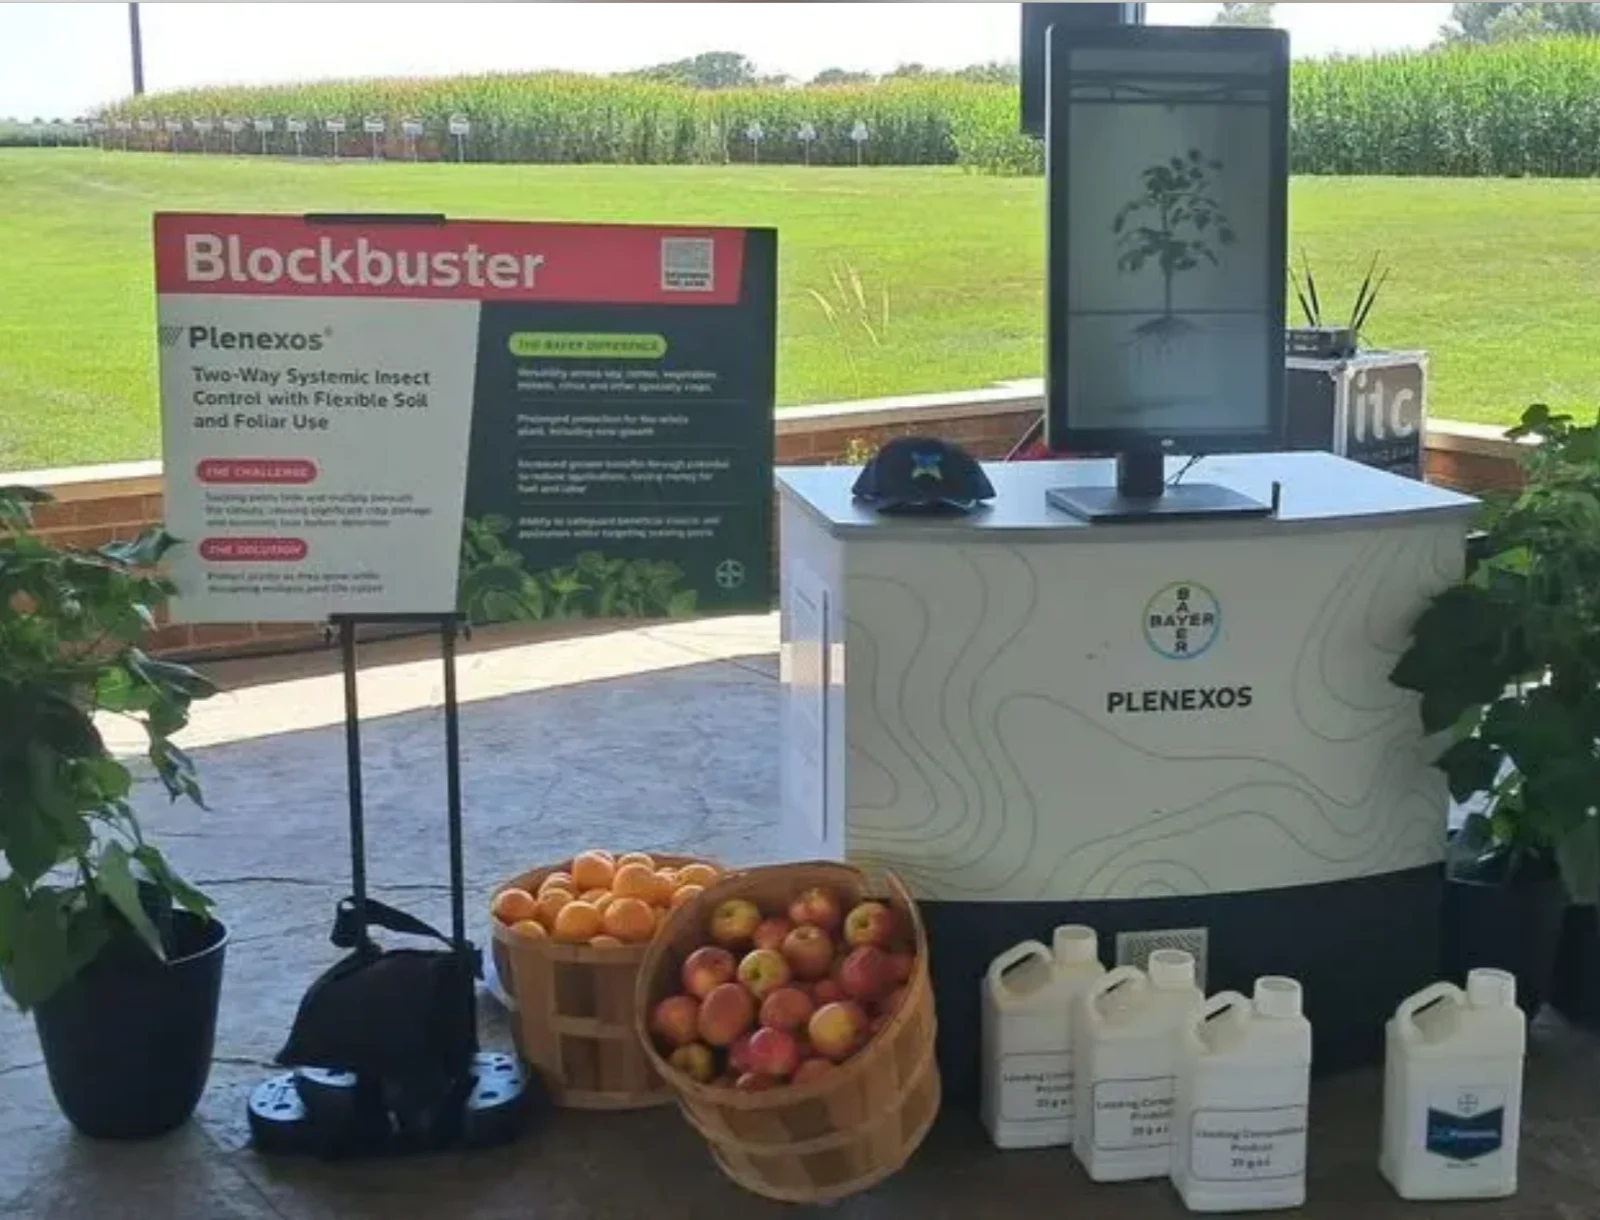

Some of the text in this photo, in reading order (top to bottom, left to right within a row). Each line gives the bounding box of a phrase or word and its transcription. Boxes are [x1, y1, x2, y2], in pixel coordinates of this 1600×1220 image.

[183, 233, 545, 289] Blockbuster
[192, 366, 431, 387] Two-Way Systemic Insect
[192, 390, 428, 408] Control with Flexible Soil
[193, 413, 330, 430] and Foliar Use
[1149, 612, 1215, 629] BAYER
[1106, 685, 1253, 714] PLENEXOS
